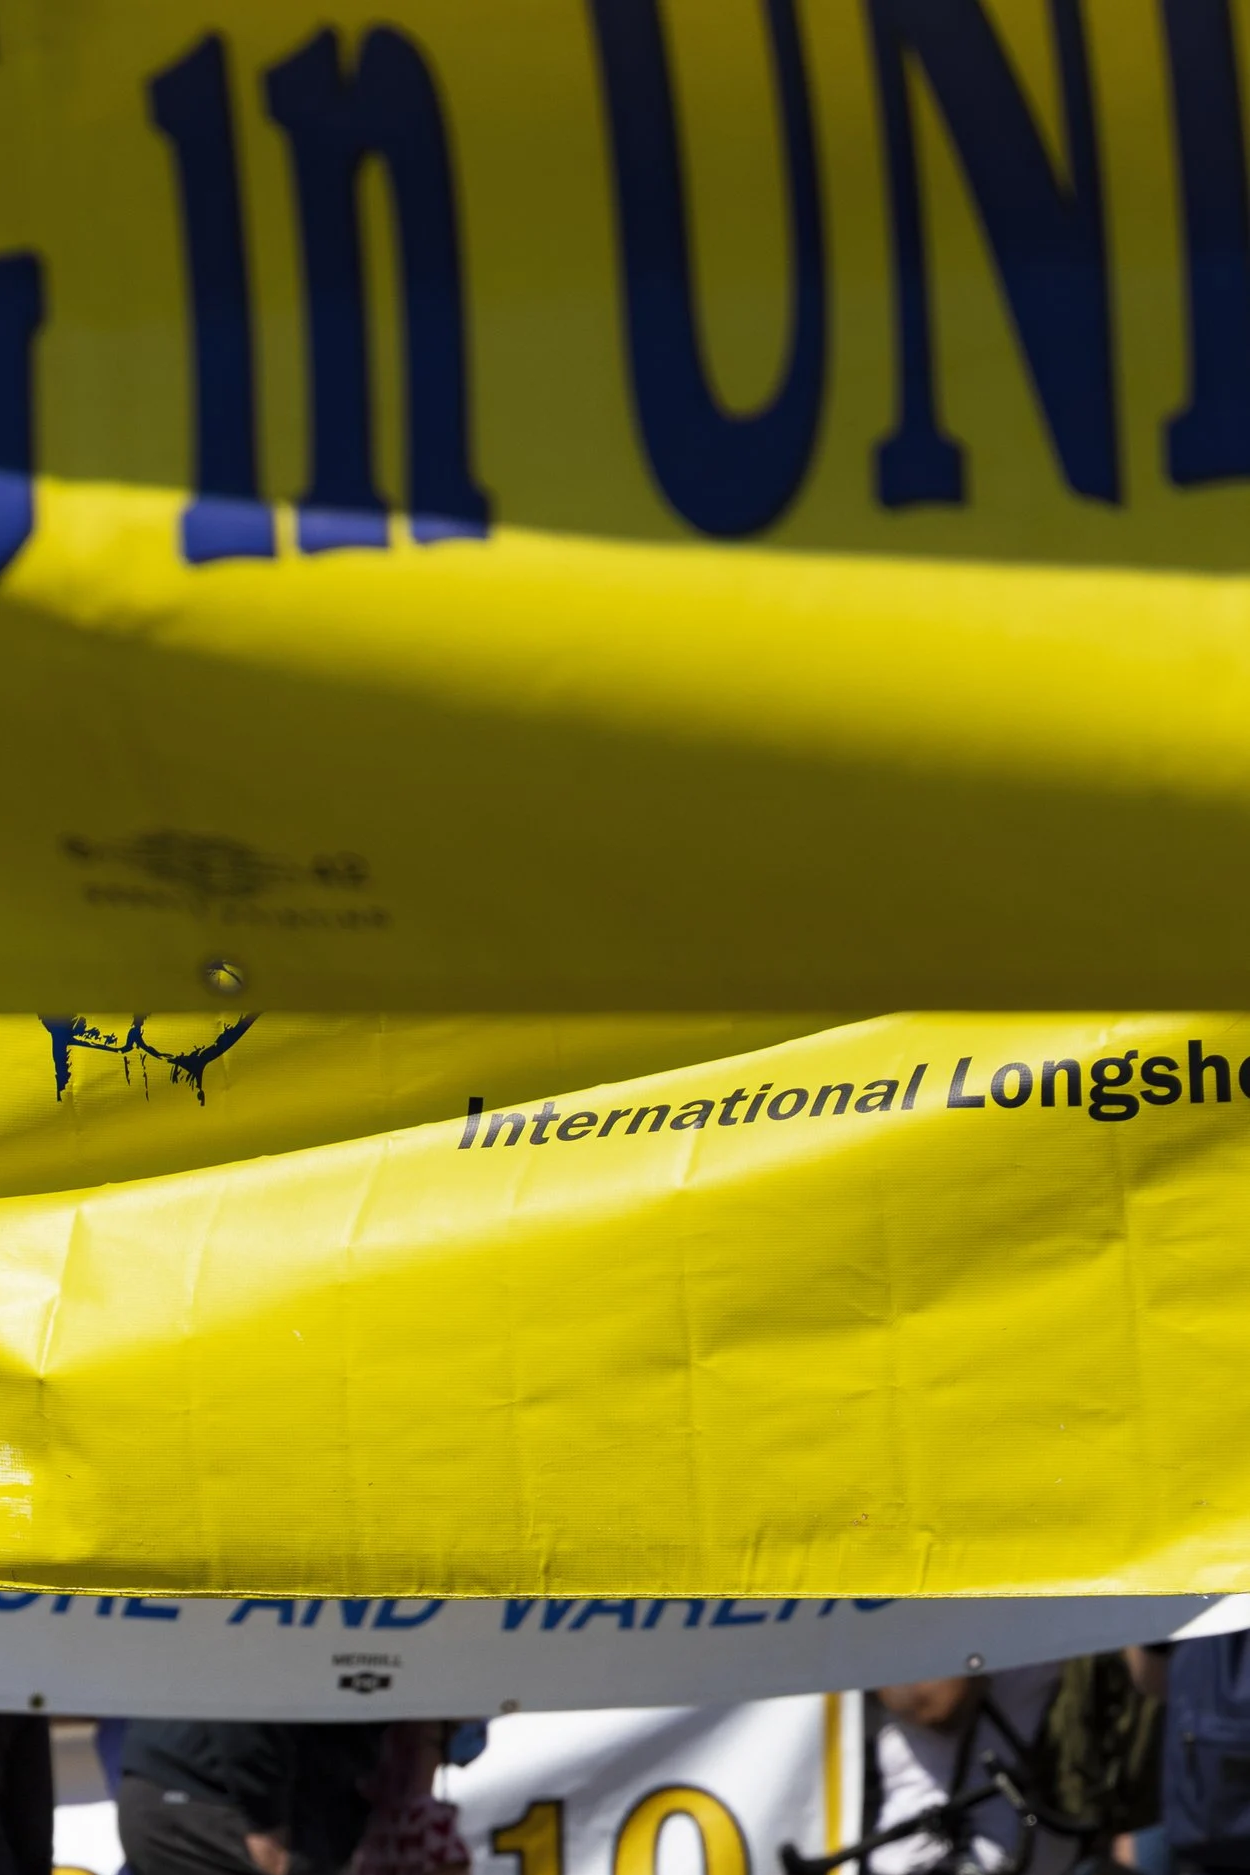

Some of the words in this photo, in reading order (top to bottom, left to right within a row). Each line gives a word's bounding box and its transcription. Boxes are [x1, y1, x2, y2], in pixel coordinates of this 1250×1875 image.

[146, 22, 494, 566] in
[457, 1063, 928, 1151] International
[945, 1038, 1250, 1124] Longsh
